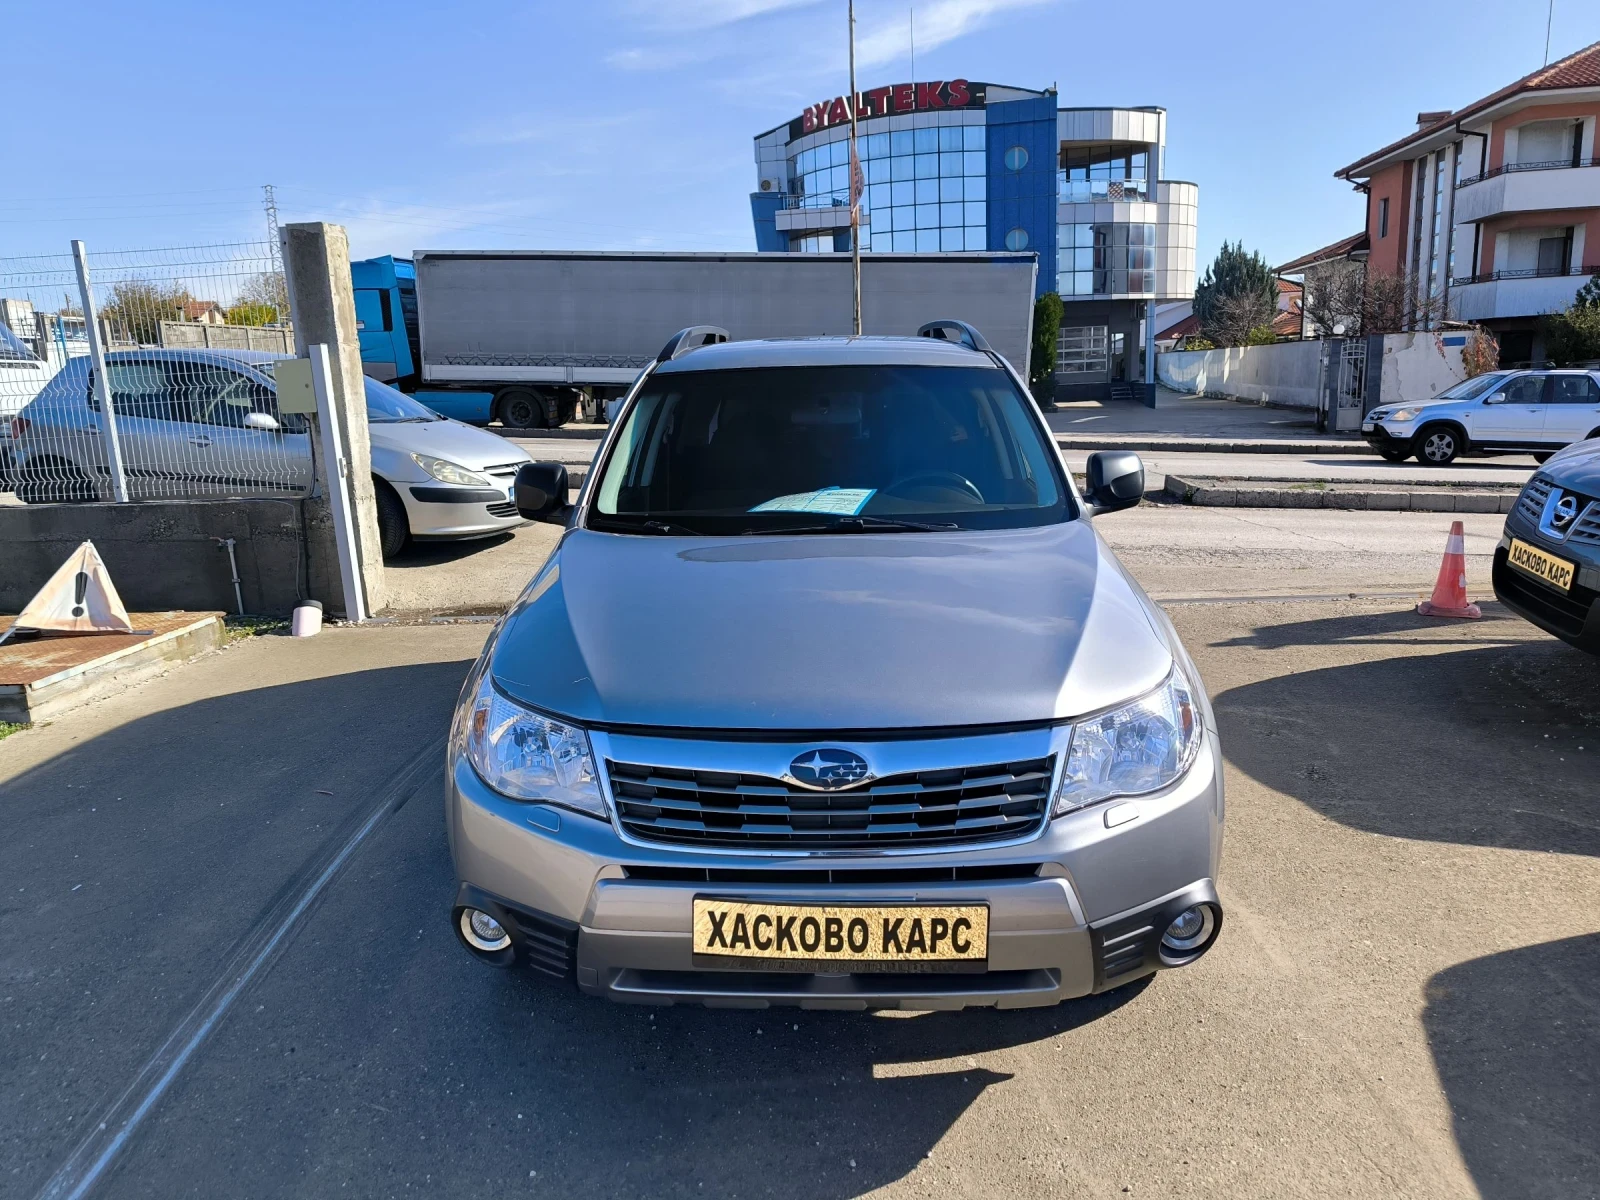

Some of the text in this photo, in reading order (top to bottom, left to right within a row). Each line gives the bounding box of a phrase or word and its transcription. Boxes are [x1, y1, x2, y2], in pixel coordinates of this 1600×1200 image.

[803, 79, 970, 133] BYALTEKS
[1512, 546, 1570, 587] ХАСКОВО КАРС
[707, 911, 971, 953] ХАСКОВО КАРС
